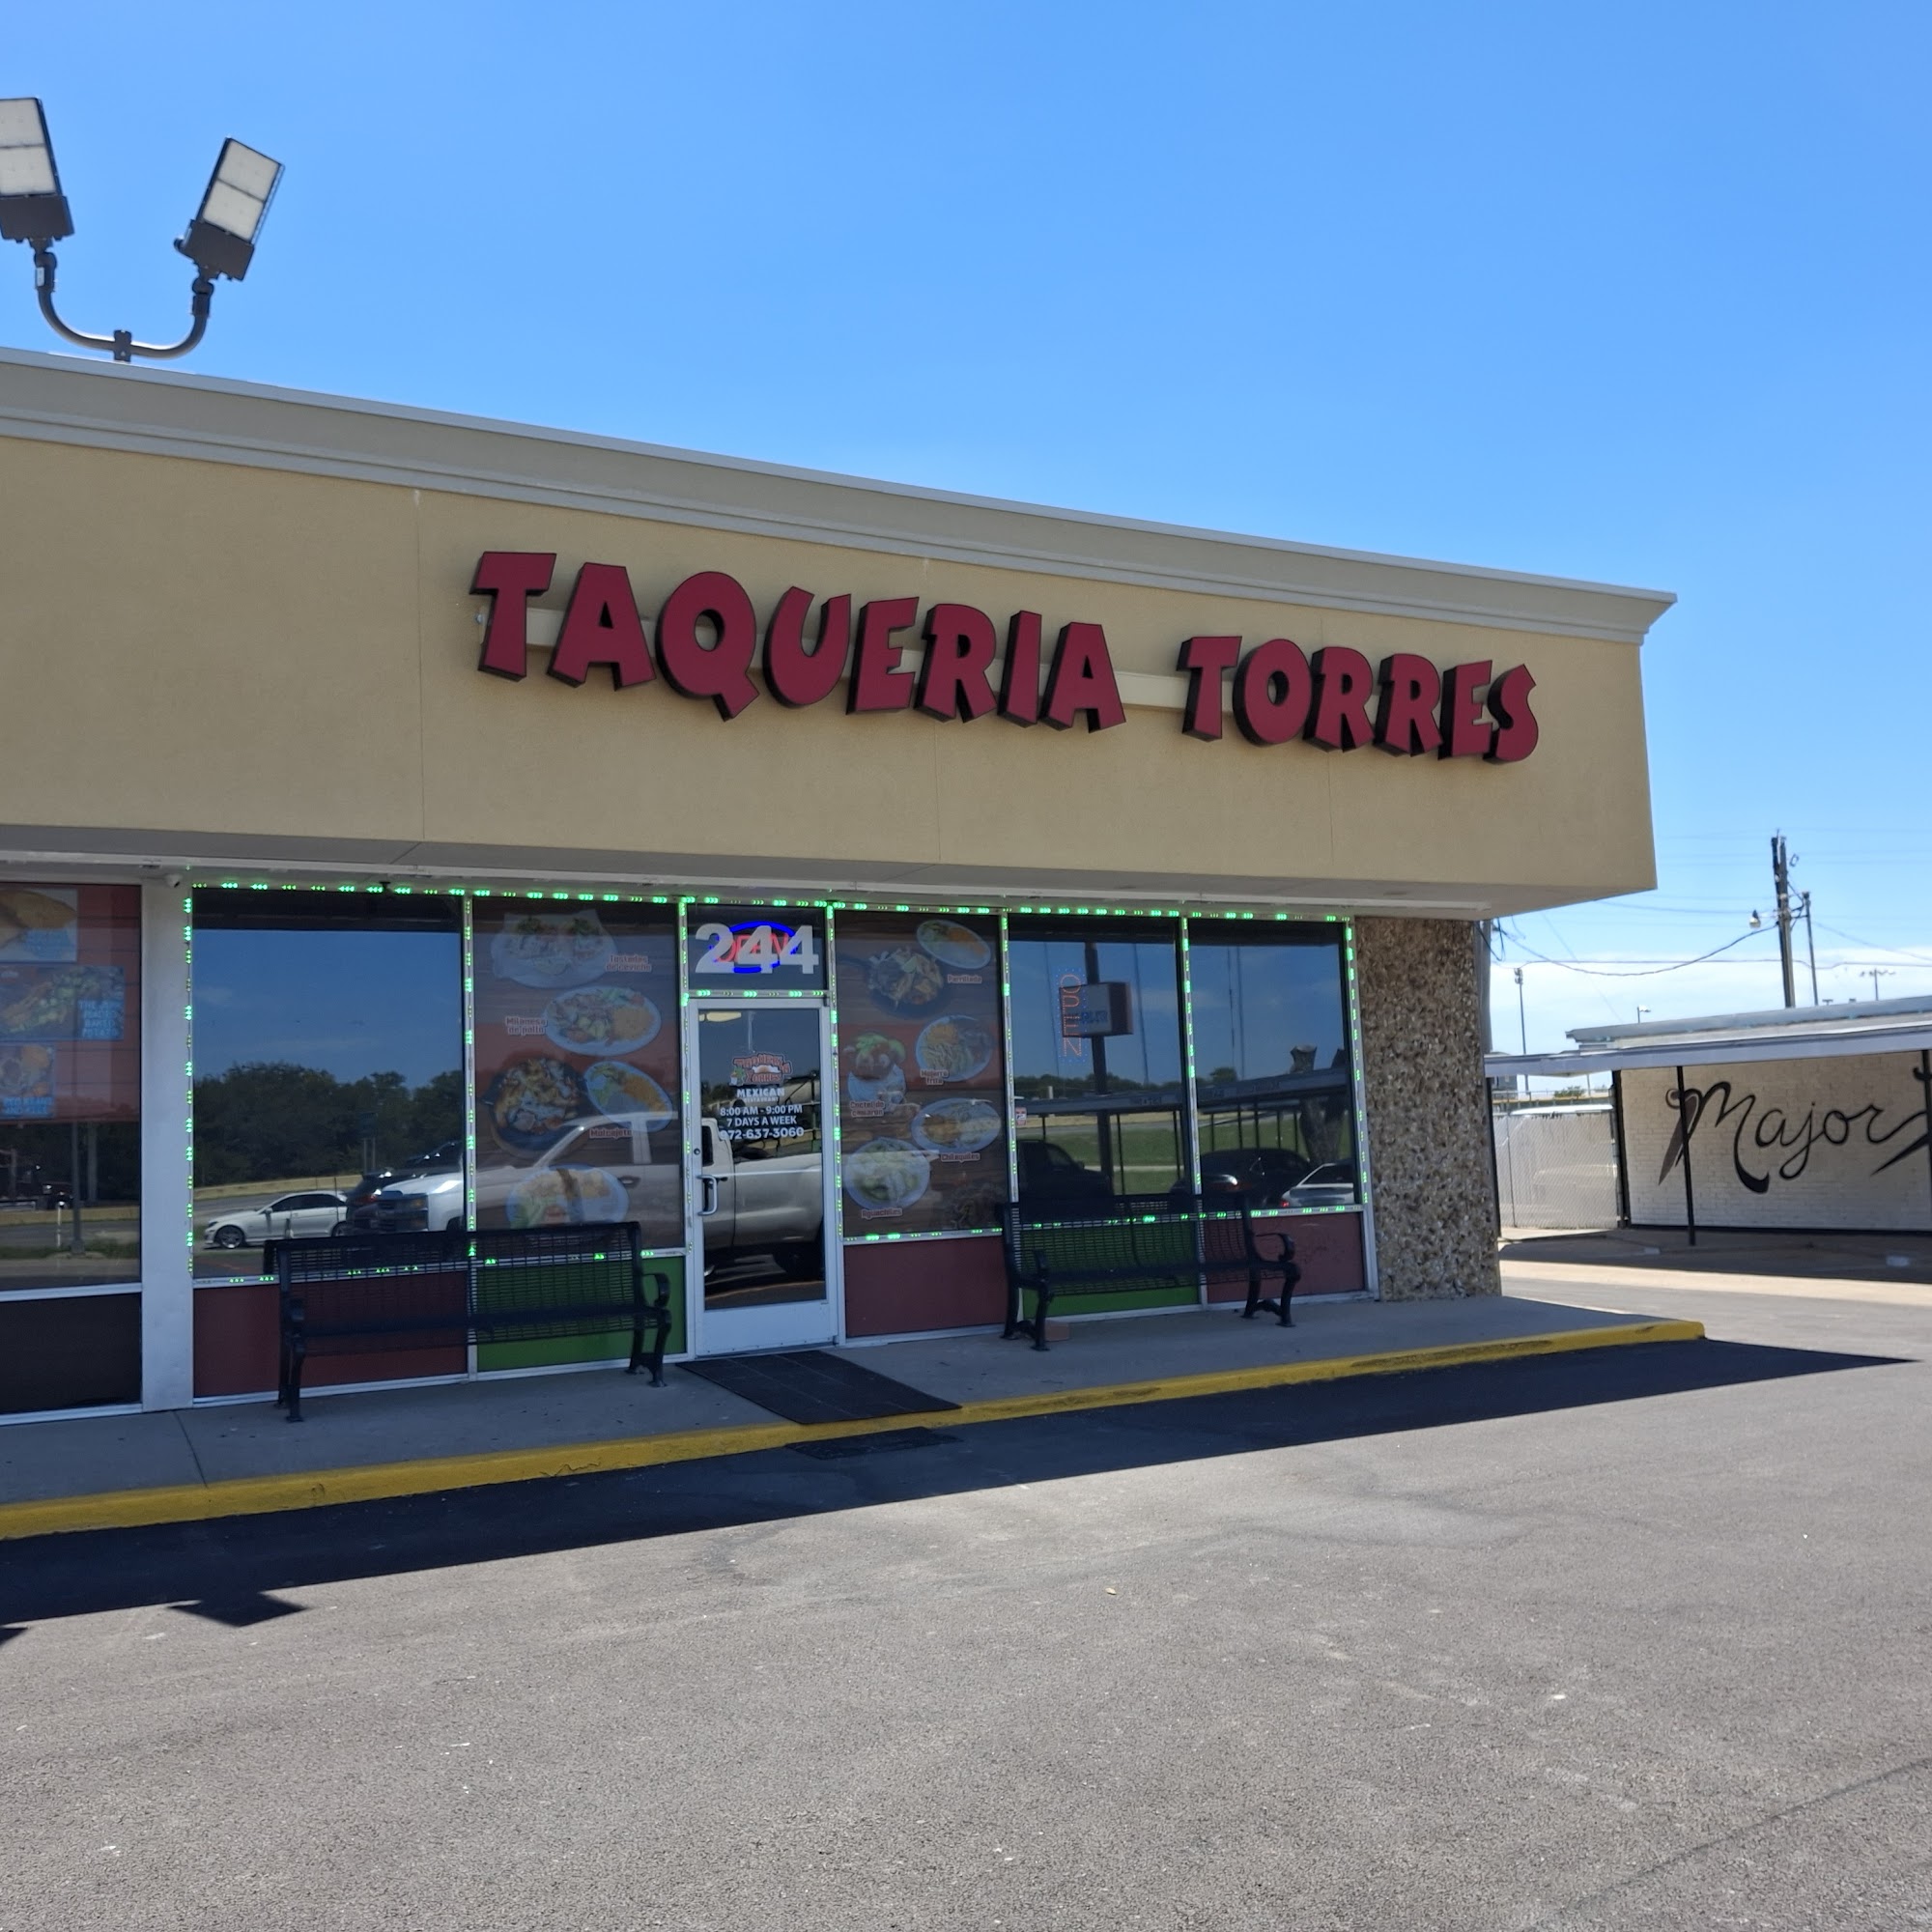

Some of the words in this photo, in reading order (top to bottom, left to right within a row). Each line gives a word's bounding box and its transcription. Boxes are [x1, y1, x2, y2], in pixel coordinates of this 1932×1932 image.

[469, 551, 1126, 733] TAQUERIA
[1176, 636, 1538, 764] TORRES
[696, 923, 819, 974] 244
[1060, 974, 1082, 1057] OPEN
[737, 1088, 785, 1098] MEXICAN
[720, 1107, 741, 1117] 8:00
[743, 1106, 759, 1116] AM
[766, 1104, 786, 1115] 9:00
[787, 1103, 803, 1114] PM
[726, 1118, 733, 1127] 7
[734, 1117, 759, 1127] DAYS
[761, 1116, 769, 1126] A
[770, 1115, 798, 1125] WEEK
[720, 1126, 805, 1140] 972-637-3060
[941, 1152, 980, 1162] Chilaquiles
[862, 1208, 902, 1219] Aguachiles
